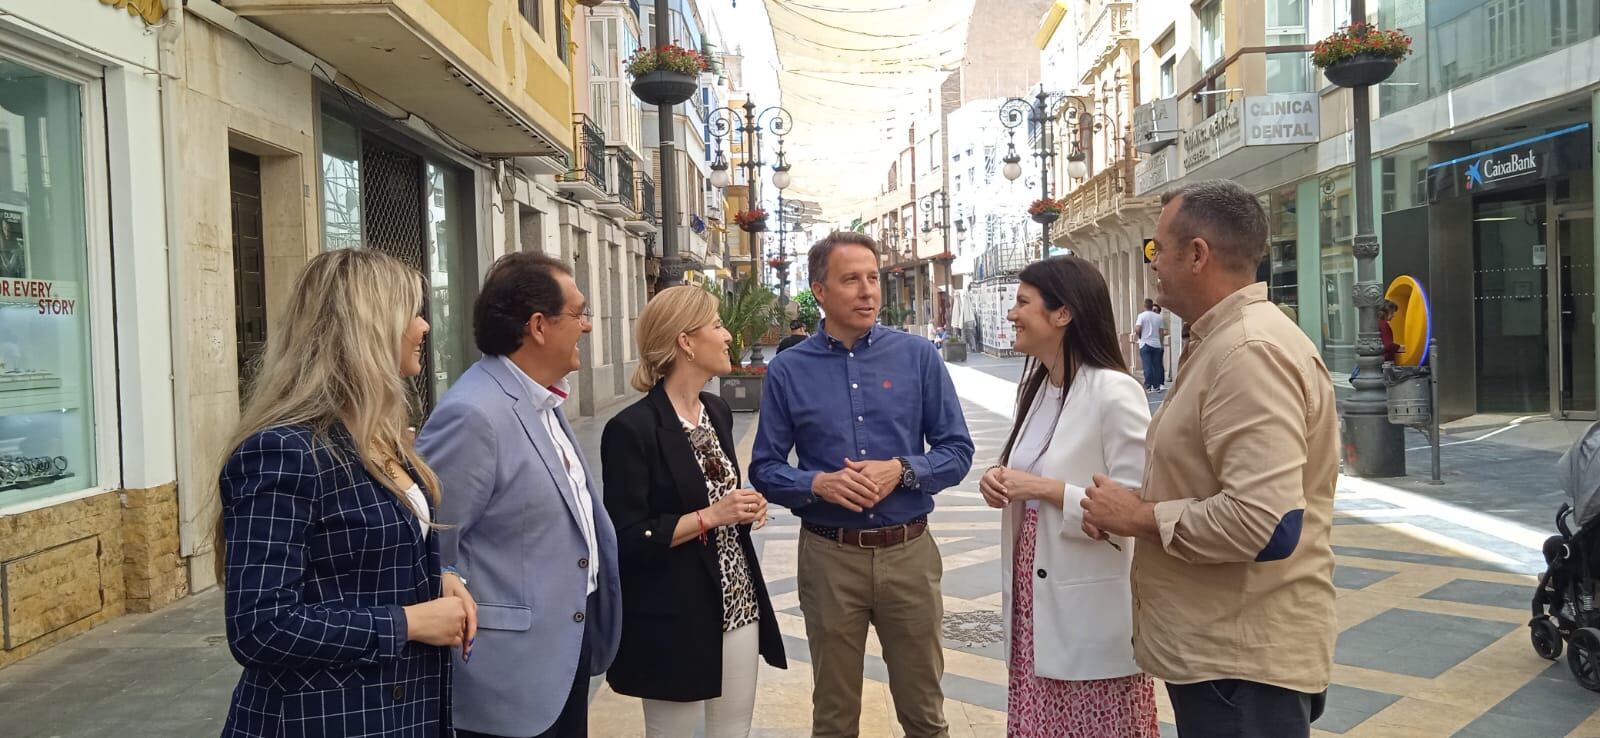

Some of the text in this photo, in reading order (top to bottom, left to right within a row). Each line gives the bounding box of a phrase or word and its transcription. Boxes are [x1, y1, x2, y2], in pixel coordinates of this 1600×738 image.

[1250, 100, 1313, 117] CLINICA
[1252, 122, 1313, 139] DENTAL
[1484, 149, 1536, 178] CaixaBank
[14, 281, 52, 298] EVERY
[38, 299, 75, 315] STORY
